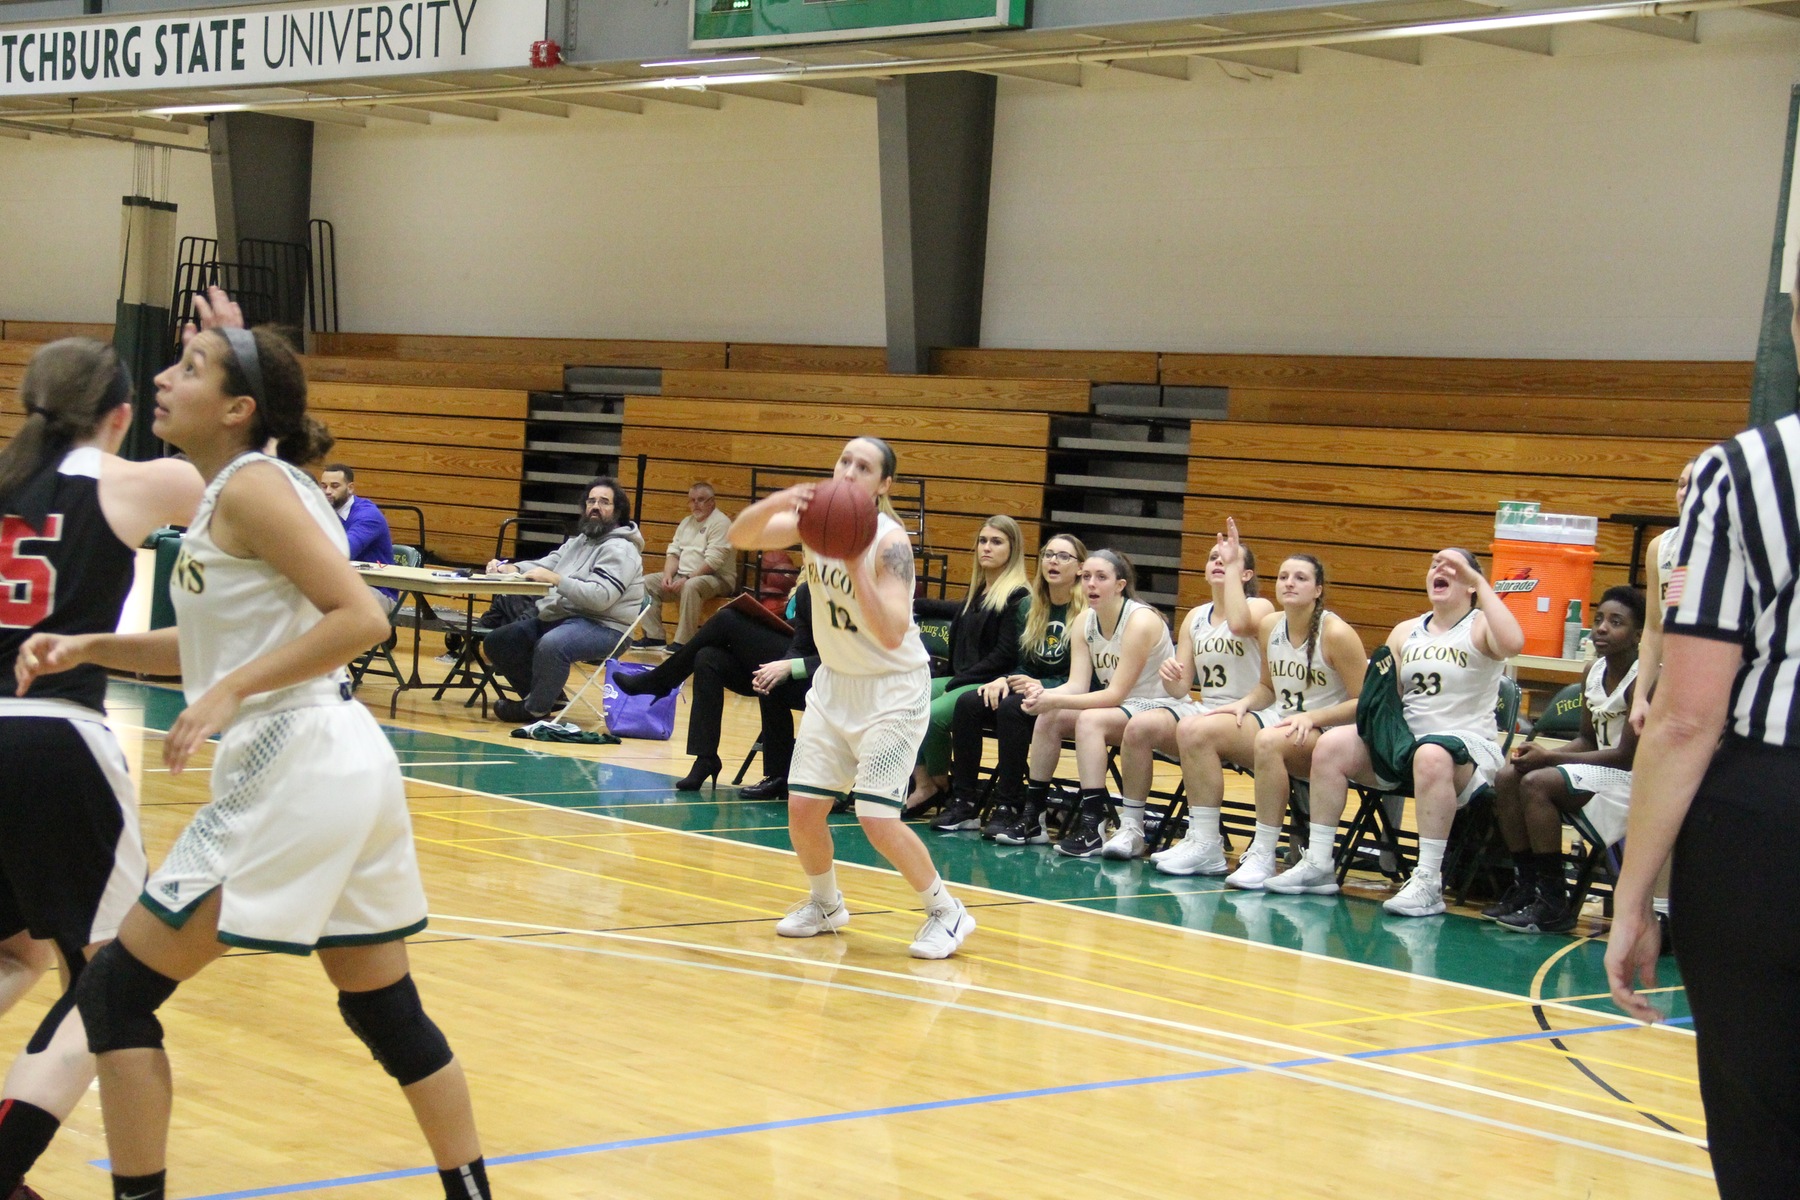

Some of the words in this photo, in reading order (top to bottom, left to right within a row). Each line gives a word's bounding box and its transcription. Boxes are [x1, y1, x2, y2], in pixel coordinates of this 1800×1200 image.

[2, 26, 141, 83] TCHBURG
[154, 18, 246, 76] STATE
[264, 0, 477, 69] UNIVERSITY
[808, 562, 856, 599] FALCO
[827, 600, 858, 633] 12
[1202, 664, 1227, 688] 23
[1411, 672, 1441, 696] 33
[1280, 688, 1307, 713] 31
